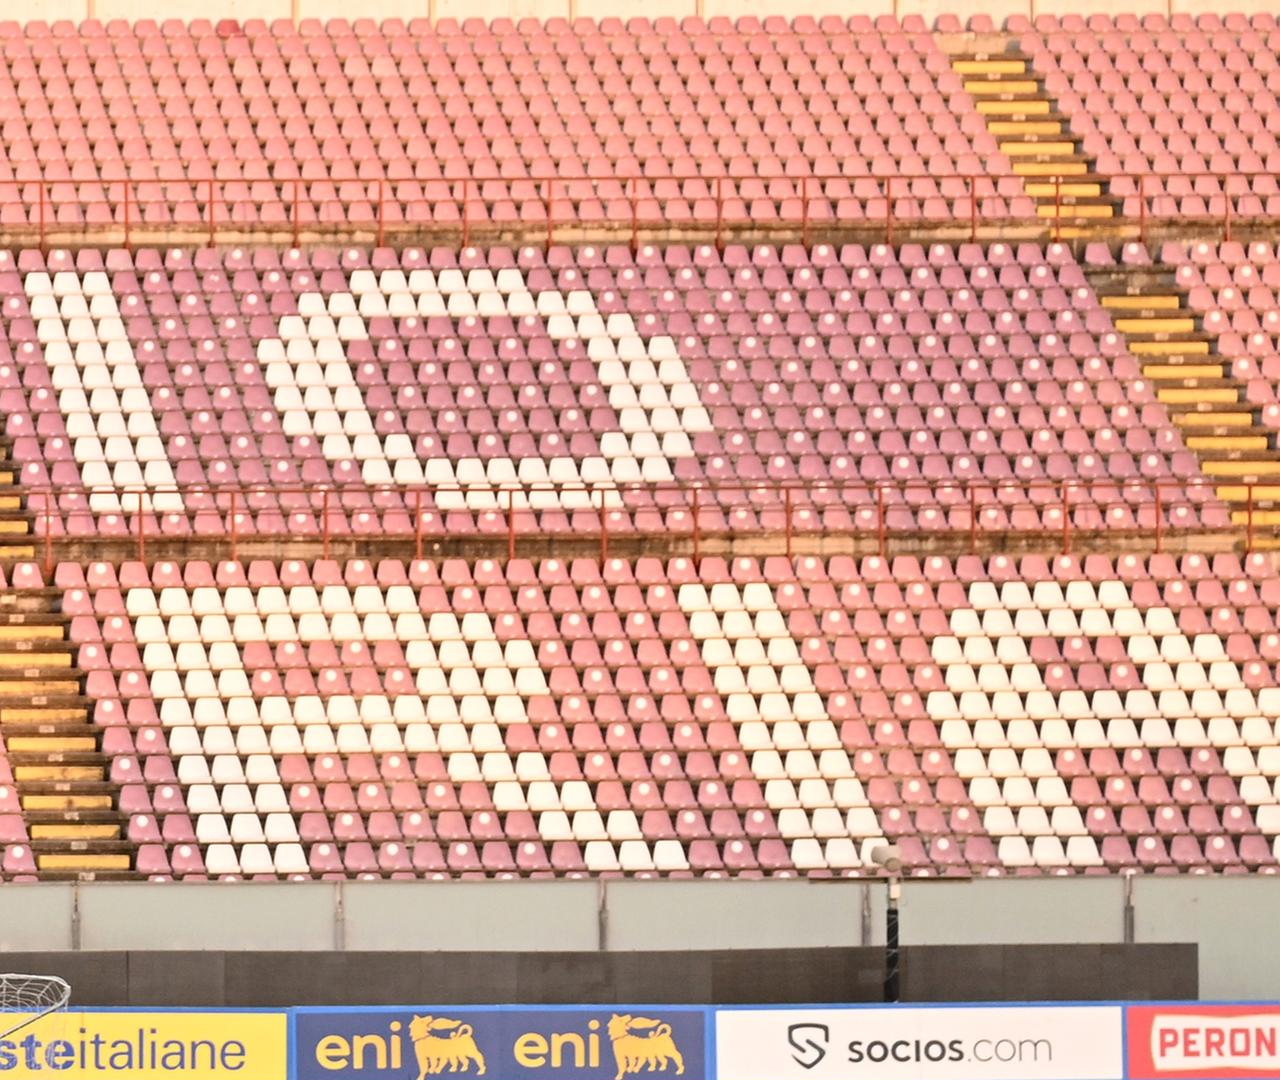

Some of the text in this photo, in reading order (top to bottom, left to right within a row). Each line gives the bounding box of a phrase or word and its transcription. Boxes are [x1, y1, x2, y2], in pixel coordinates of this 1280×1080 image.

[316, 1020, 402, 1069] eni
[513, 1019, 601, 1068] eni
[1159, 1027, 1277, 1057] PERON
